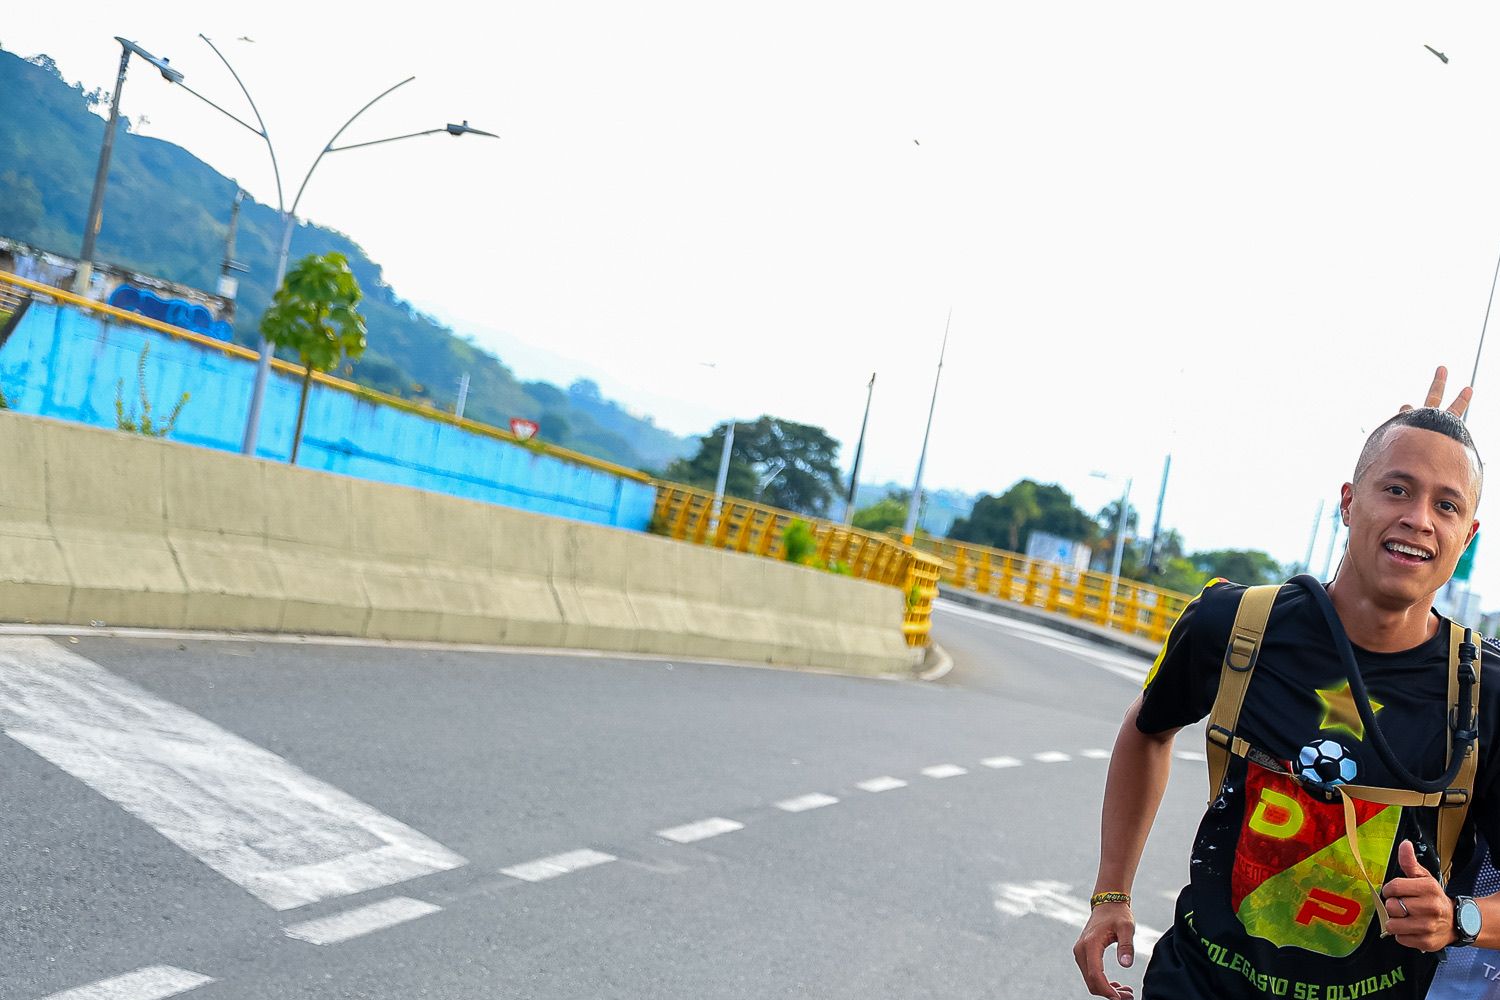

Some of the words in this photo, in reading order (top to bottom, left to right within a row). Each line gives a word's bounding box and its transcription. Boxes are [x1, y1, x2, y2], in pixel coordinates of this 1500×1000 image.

[1249, 787, 1304, 839] D
[1295, 887, 1361, 926] P
[1294, 982, 1320, 1000] SE
